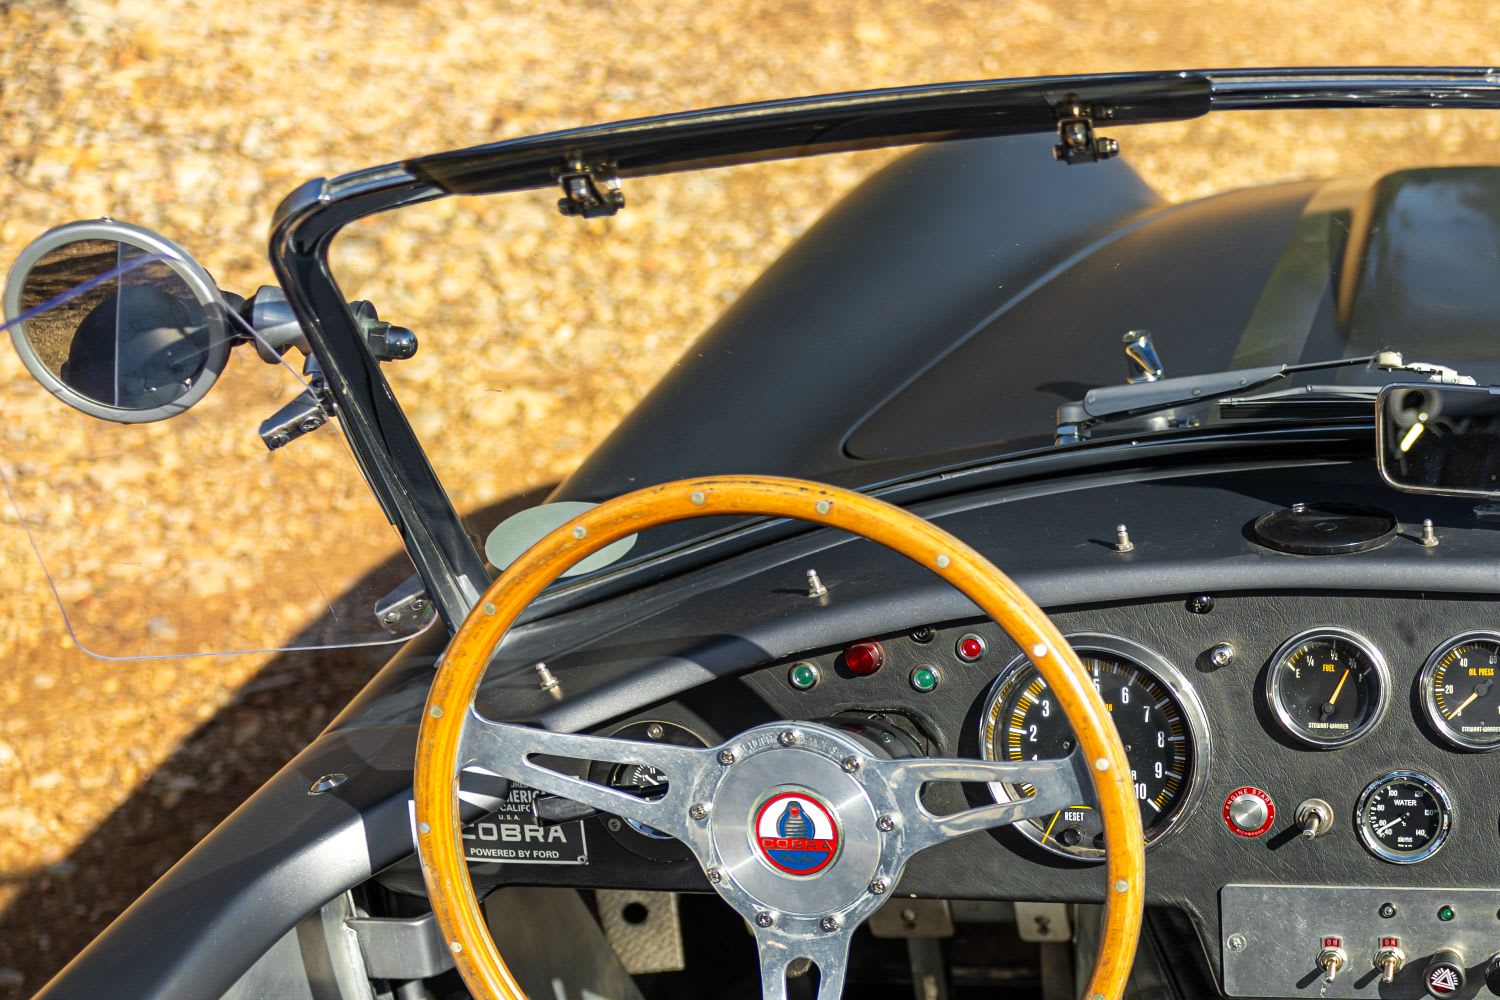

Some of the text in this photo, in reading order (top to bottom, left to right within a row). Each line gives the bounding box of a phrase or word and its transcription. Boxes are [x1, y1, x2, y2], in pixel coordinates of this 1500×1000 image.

[1322, 664, 1335, 673] FUEL
[1459, 658, 1468, 668] 40
[1296, 670, 1300, 679] E
[1468, 668, 1495, 677] OIL PRESS
[1444, 684, 1454, 694] 20
[1121, 687, 1129, 704] 6
[1042, 700, 1050, 717] 3
[1143, 706, 1150, 723] 7
[1029, 725, 1038, 742] 2
[1157, 731, 1165, 748] 8
[1154, 762, 1162, 779] 9
[1225, 789, 1274, 810] ENGINE START
[1064, 812, 1084, 822] RESET
[762, 839, 832, 850] COBRA
[470, 847, 560, 859] POWERED BY FORD
